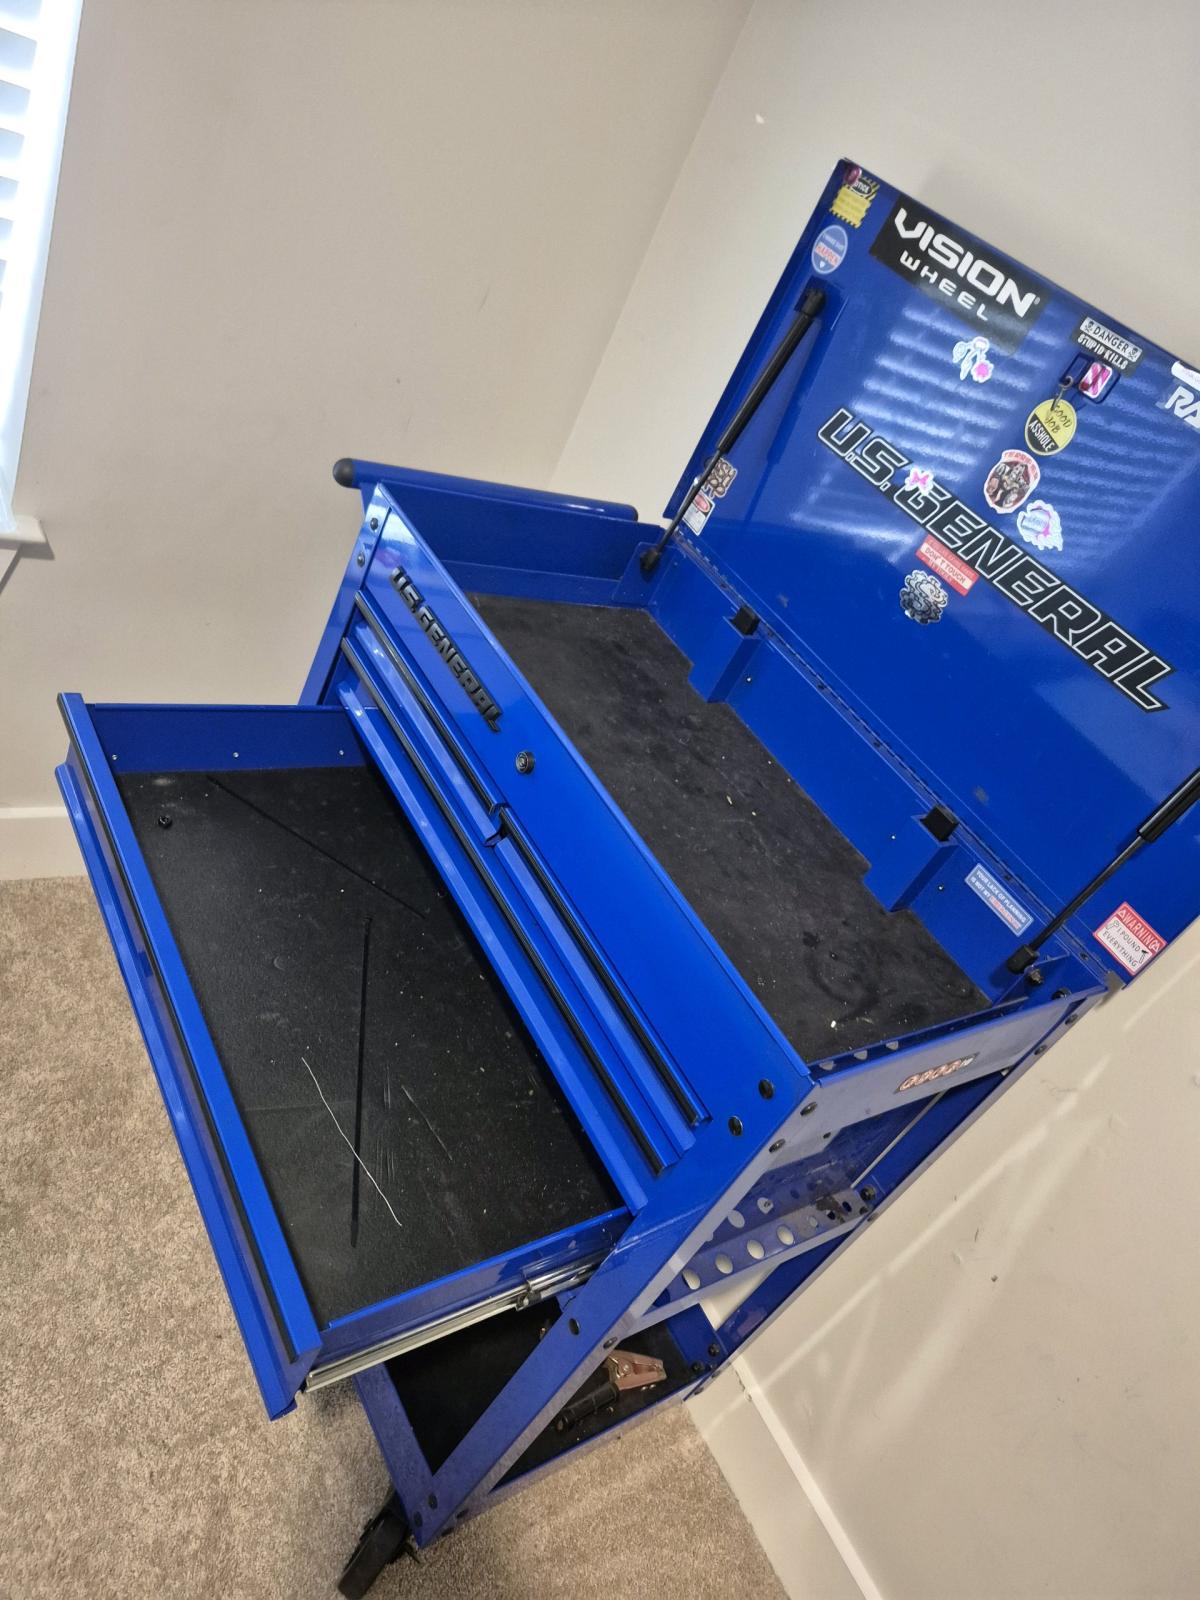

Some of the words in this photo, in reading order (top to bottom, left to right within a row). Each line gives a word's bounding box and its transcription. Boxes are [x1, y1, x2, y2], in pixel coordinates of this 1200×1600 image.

[894, 207, 1037, 318] VISION
[899, 250, 989, 322] WHEEL
[1076, 332, 1105, 355] STUPID
[1103, 349, 1128, 370] KILLS
[1092, 325, 1129, 353] DANGER
[1028, 419, 1054, 451] ASSHOLE
[817, 407, 910, 492] U.S.
[893, 479, 1172, 710] GENERAL
[944, 564, 965, 583] TOUCH
[986, 881, 999, 894] LACK
[997, 892, 1005, 901] OF
[1003, 899, 1026, 923] PLANNING
[1102, 931, 1138, 967] EVERYTHING
[1119, 930, 1140, 952] POUND
[1123, 911, 1158, 950] WARNING
